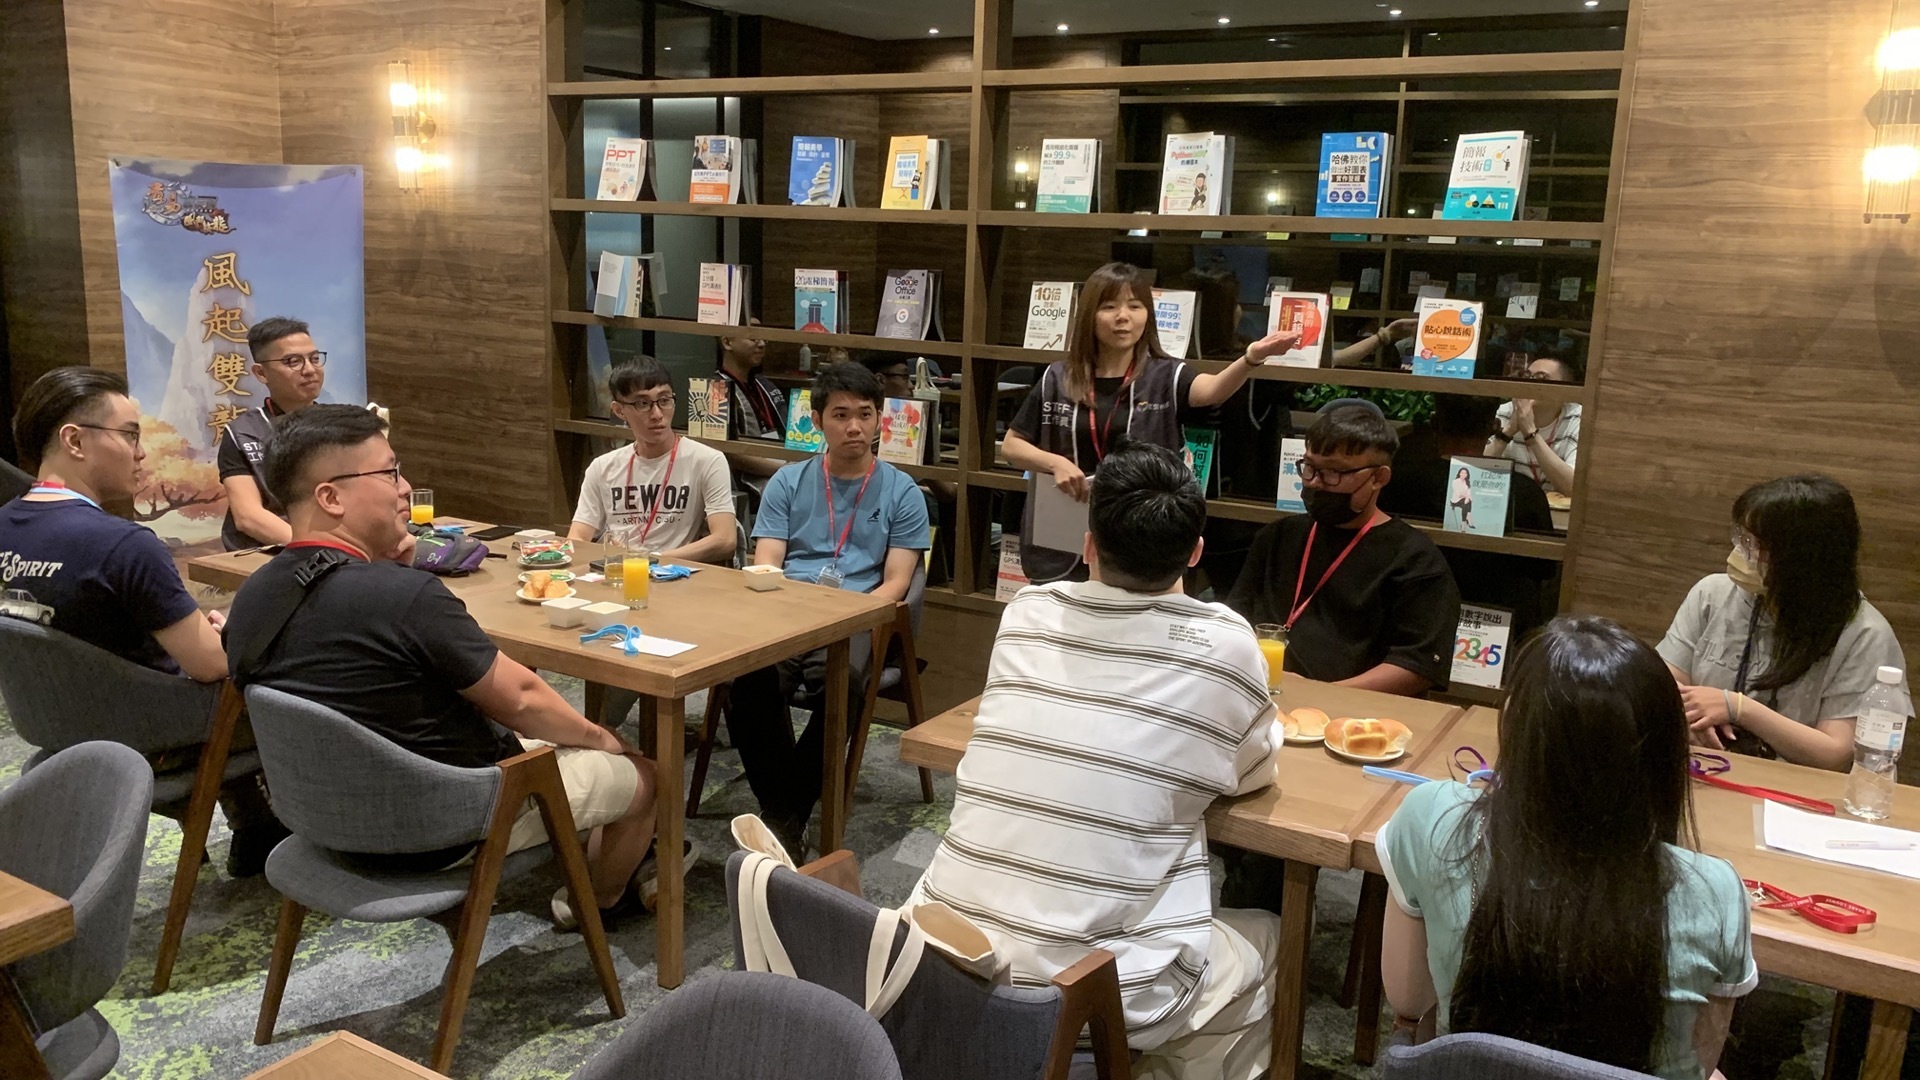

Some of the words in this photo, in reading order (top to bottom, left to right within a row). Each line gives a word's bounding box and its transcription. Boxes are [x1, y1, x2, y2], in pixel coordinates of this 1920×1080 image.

[605, 149, 637, 162] PPT
[895, 277, 919, 288] Google
[895, 286, 916, 296] Office
[1031, 305, 1067, 320] Google
[1424, 325, 1472, 337] 貼心說話術
[3, 554, 63, 582] SPIRIT
